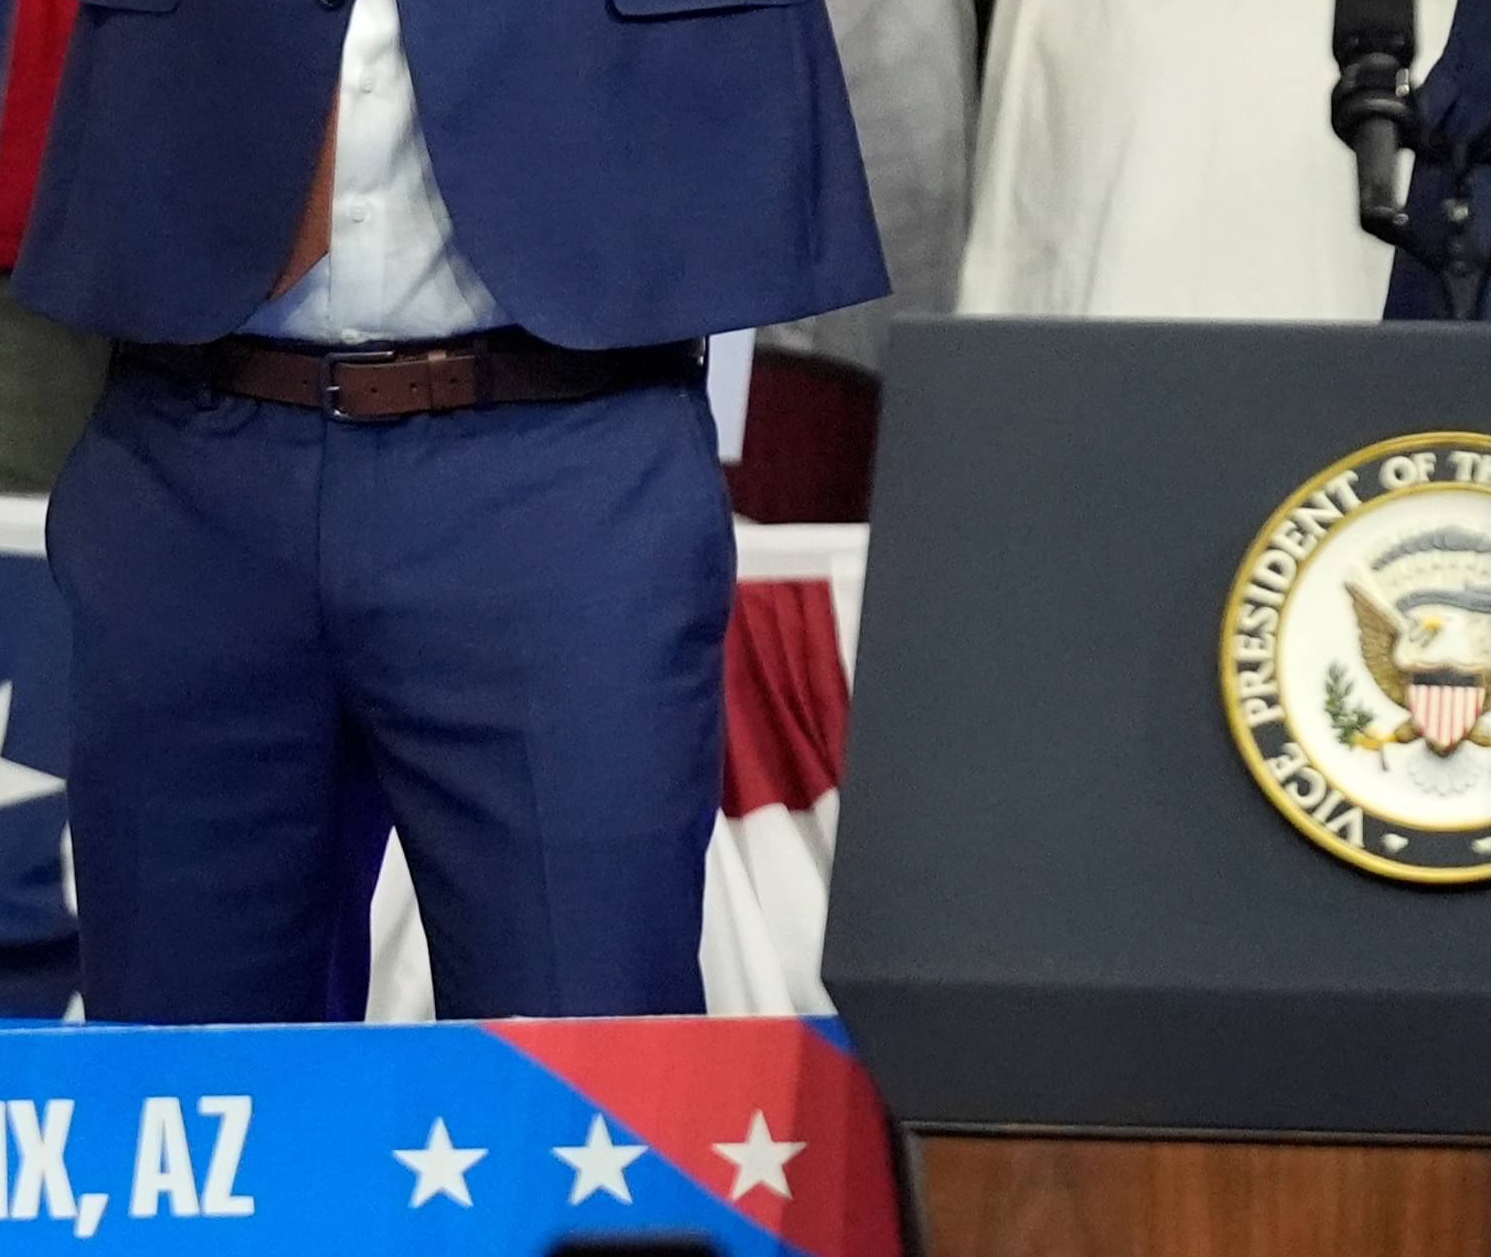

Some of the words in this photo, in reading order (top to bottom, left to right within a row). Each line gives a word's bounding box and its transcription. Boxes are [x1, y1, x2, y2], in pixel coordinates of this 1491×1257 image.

[1379, 452, 1438, 492] OF
[1236, 469, 1363, 728] PRESIDENT
[1269, 741, 1365, 849] VICE
[129, 1094, 256, 1219] AZ
